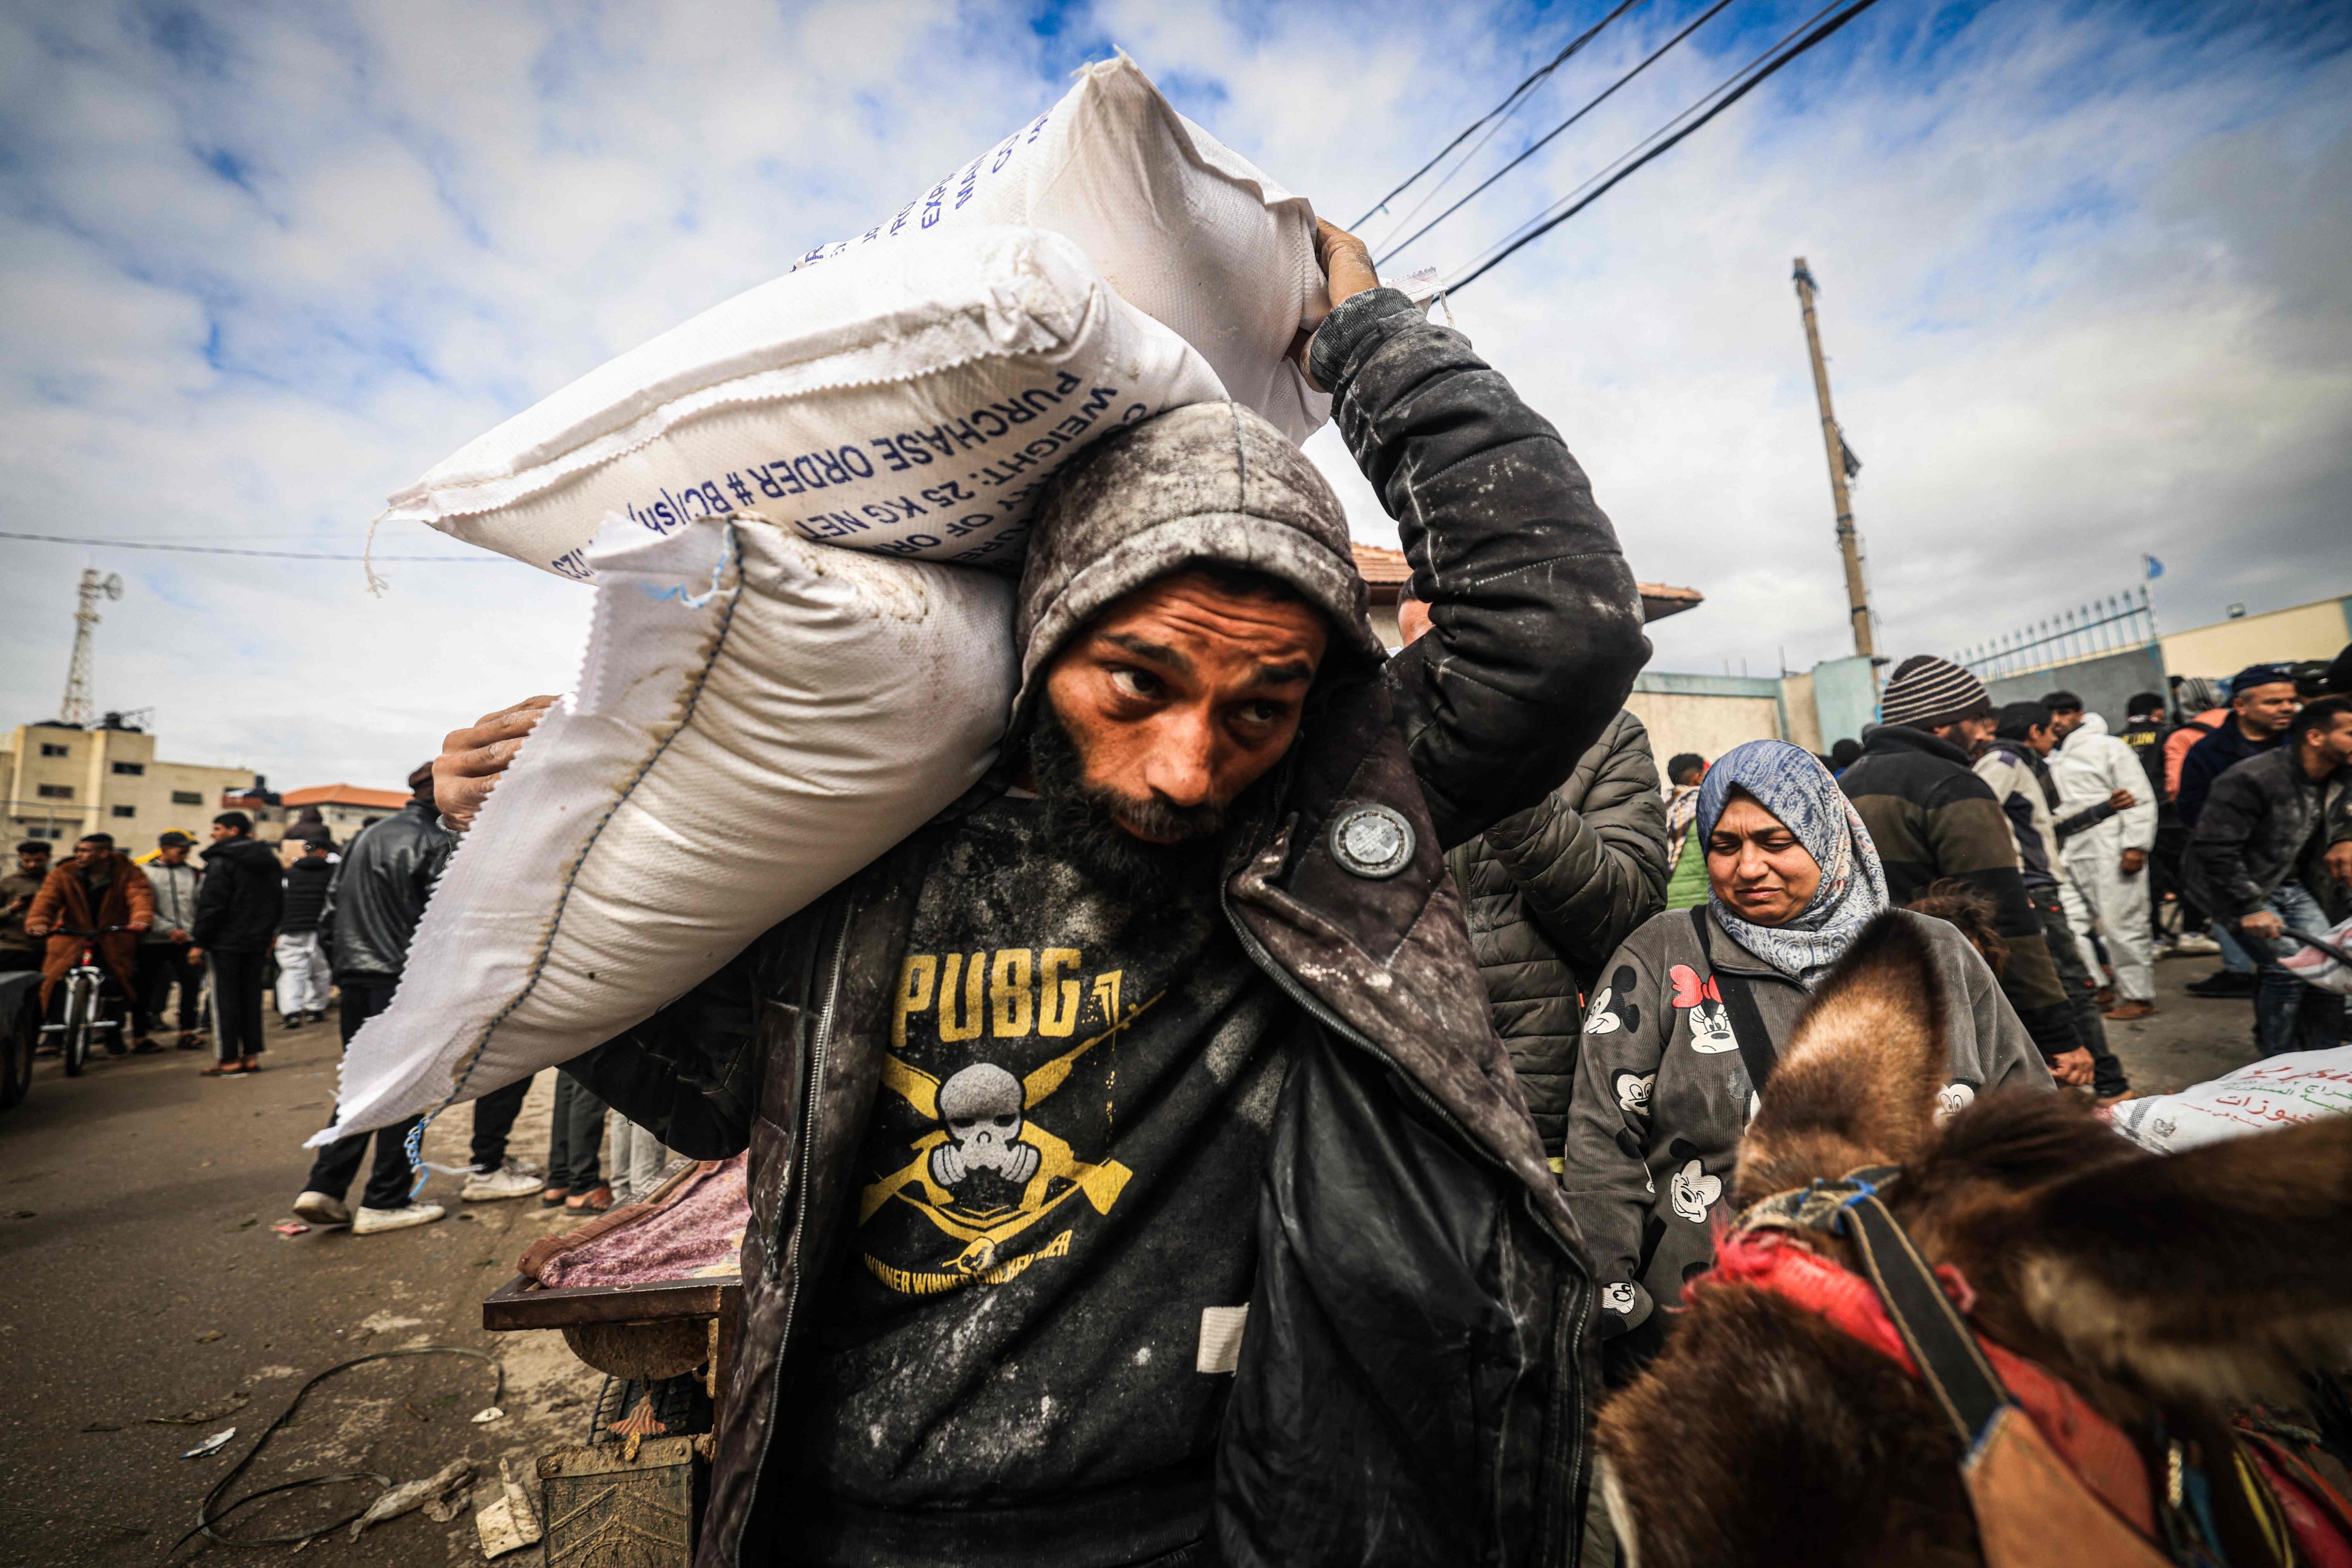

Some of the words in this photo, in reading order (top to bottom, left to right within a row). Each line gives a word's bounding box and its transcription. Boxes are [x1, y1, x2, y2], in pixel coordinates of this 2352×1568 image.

[870, 370, 1082, 472] PURCHASE
[970, 387, 1118, 485] WEIGHT:
[726, 472, 756, 506] #
[746, 445, 874, 499] ORDER
[862, 495, 928, 524] KG
[922, 480, 975, 508] 25
[794, 509, 871, 540] NET
[946, 513, 995, 538] OF
[891, 948, 1082, 1048] PUBG
[864, 1252, 910, 1293] WINNER
